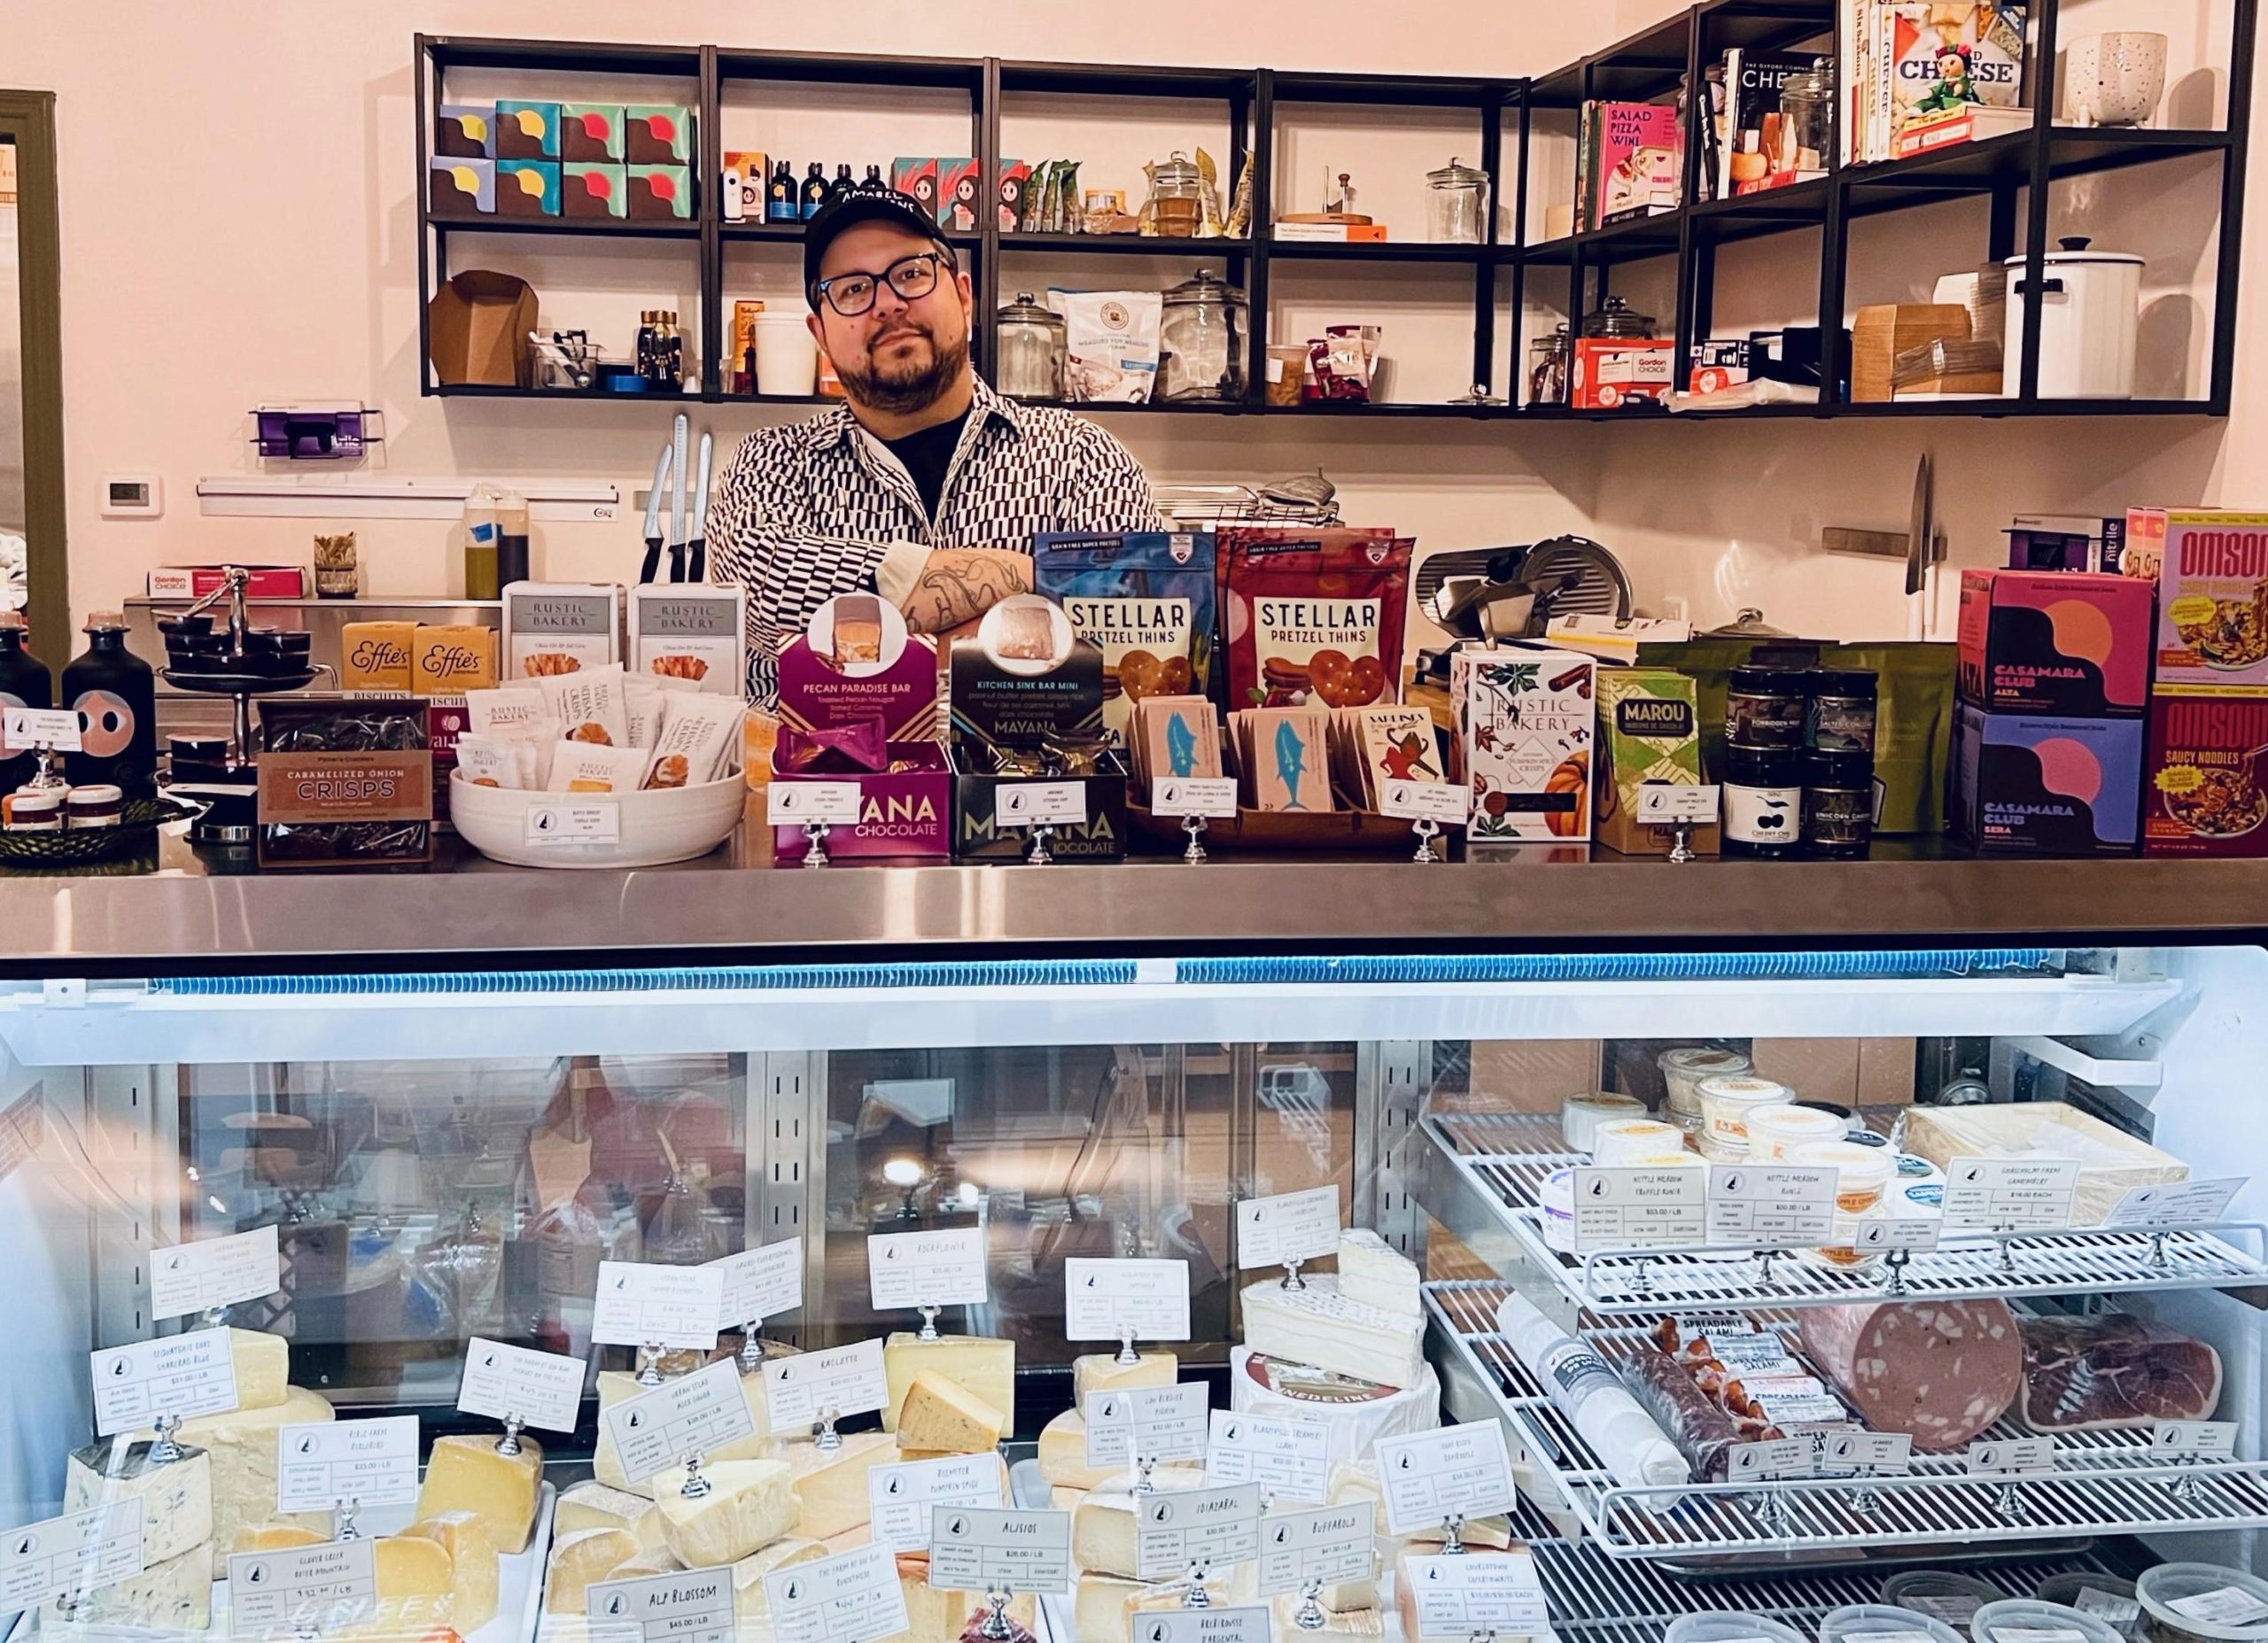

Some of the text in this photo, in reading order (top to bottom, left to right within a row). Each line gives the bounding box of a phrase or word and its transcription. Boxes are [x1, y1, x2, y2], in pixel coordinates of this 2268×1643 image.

[1899, 60, 2014, 83] CHESE
[1611, 110, 1652, 121] SALAD
[1611, 122, 1642, 135] PIZZA
[1611, 135, 1642, 147] WINE
[2105, 523, 2118, 562] nitrile
[533, 603, 586, 614] RUSTIC
[661, 606, 714, 616] RUSTIC
[533, 616, 586, 626] BAKERY
[1071, 603, 1184, 628] STELLAR
[1262, 603, 1375, 628] STELLAR
[661, 618, 714, 629] BAKERY
[1135, 631, 1175, 643] THINS
[1271, 630, 1367, 643] PRETZEL THINS
[351, 640, 408, 674] Effie's
[422, 645, 480, 678] Effie's
[1994, 664, 2086, 679] CASAMARA
[1038, 681, 1057, 690] BAR
[1994, 677, 2036, 687] CLUB
[803, 684, 911, 694] PECAN PARADISE BAR
[1496, 699, 1571, 713] RUSTIC
[1625, 702, 1684, 721] MAROU
[995, 720, 1057, 733] MAYANA
[1496, 717, 1571, 731] BAKERY
[1751, 718, 1788, 727] FORBIDDEN
[2165, 750, 2240, 765] SAUCY NOODLES
[287, 769, 405, 779] CARAMELIZED ONION
[297, 779, 395, 800] CRISPS
[1984, 802, 2075, 817] CASAMARA
[1984, 813, 2025, 825] CLUB
[855, 824, 938, 837] CHOCOLATE
[1984, 825, 2012, 834] SERA
[1052, 841, 1115, 854] OCOLATE
[1683, 1319, 1744, 1329] SPREADABLE
[820, 1354, 858, 1368] RACLETTE
[1743, 1360, 1781, 1371] SALAMI
[930, 1483, 960, 1493] PUMPKIN
[1196, 1498, 1239, 1515] IDIAZABAL
[1312, 1516, 1356, 1534] BUFFAROLO
[649, 1585, 718, 1608] ALP BLOSSOM
[698, 1616, 709, 1625] LB
